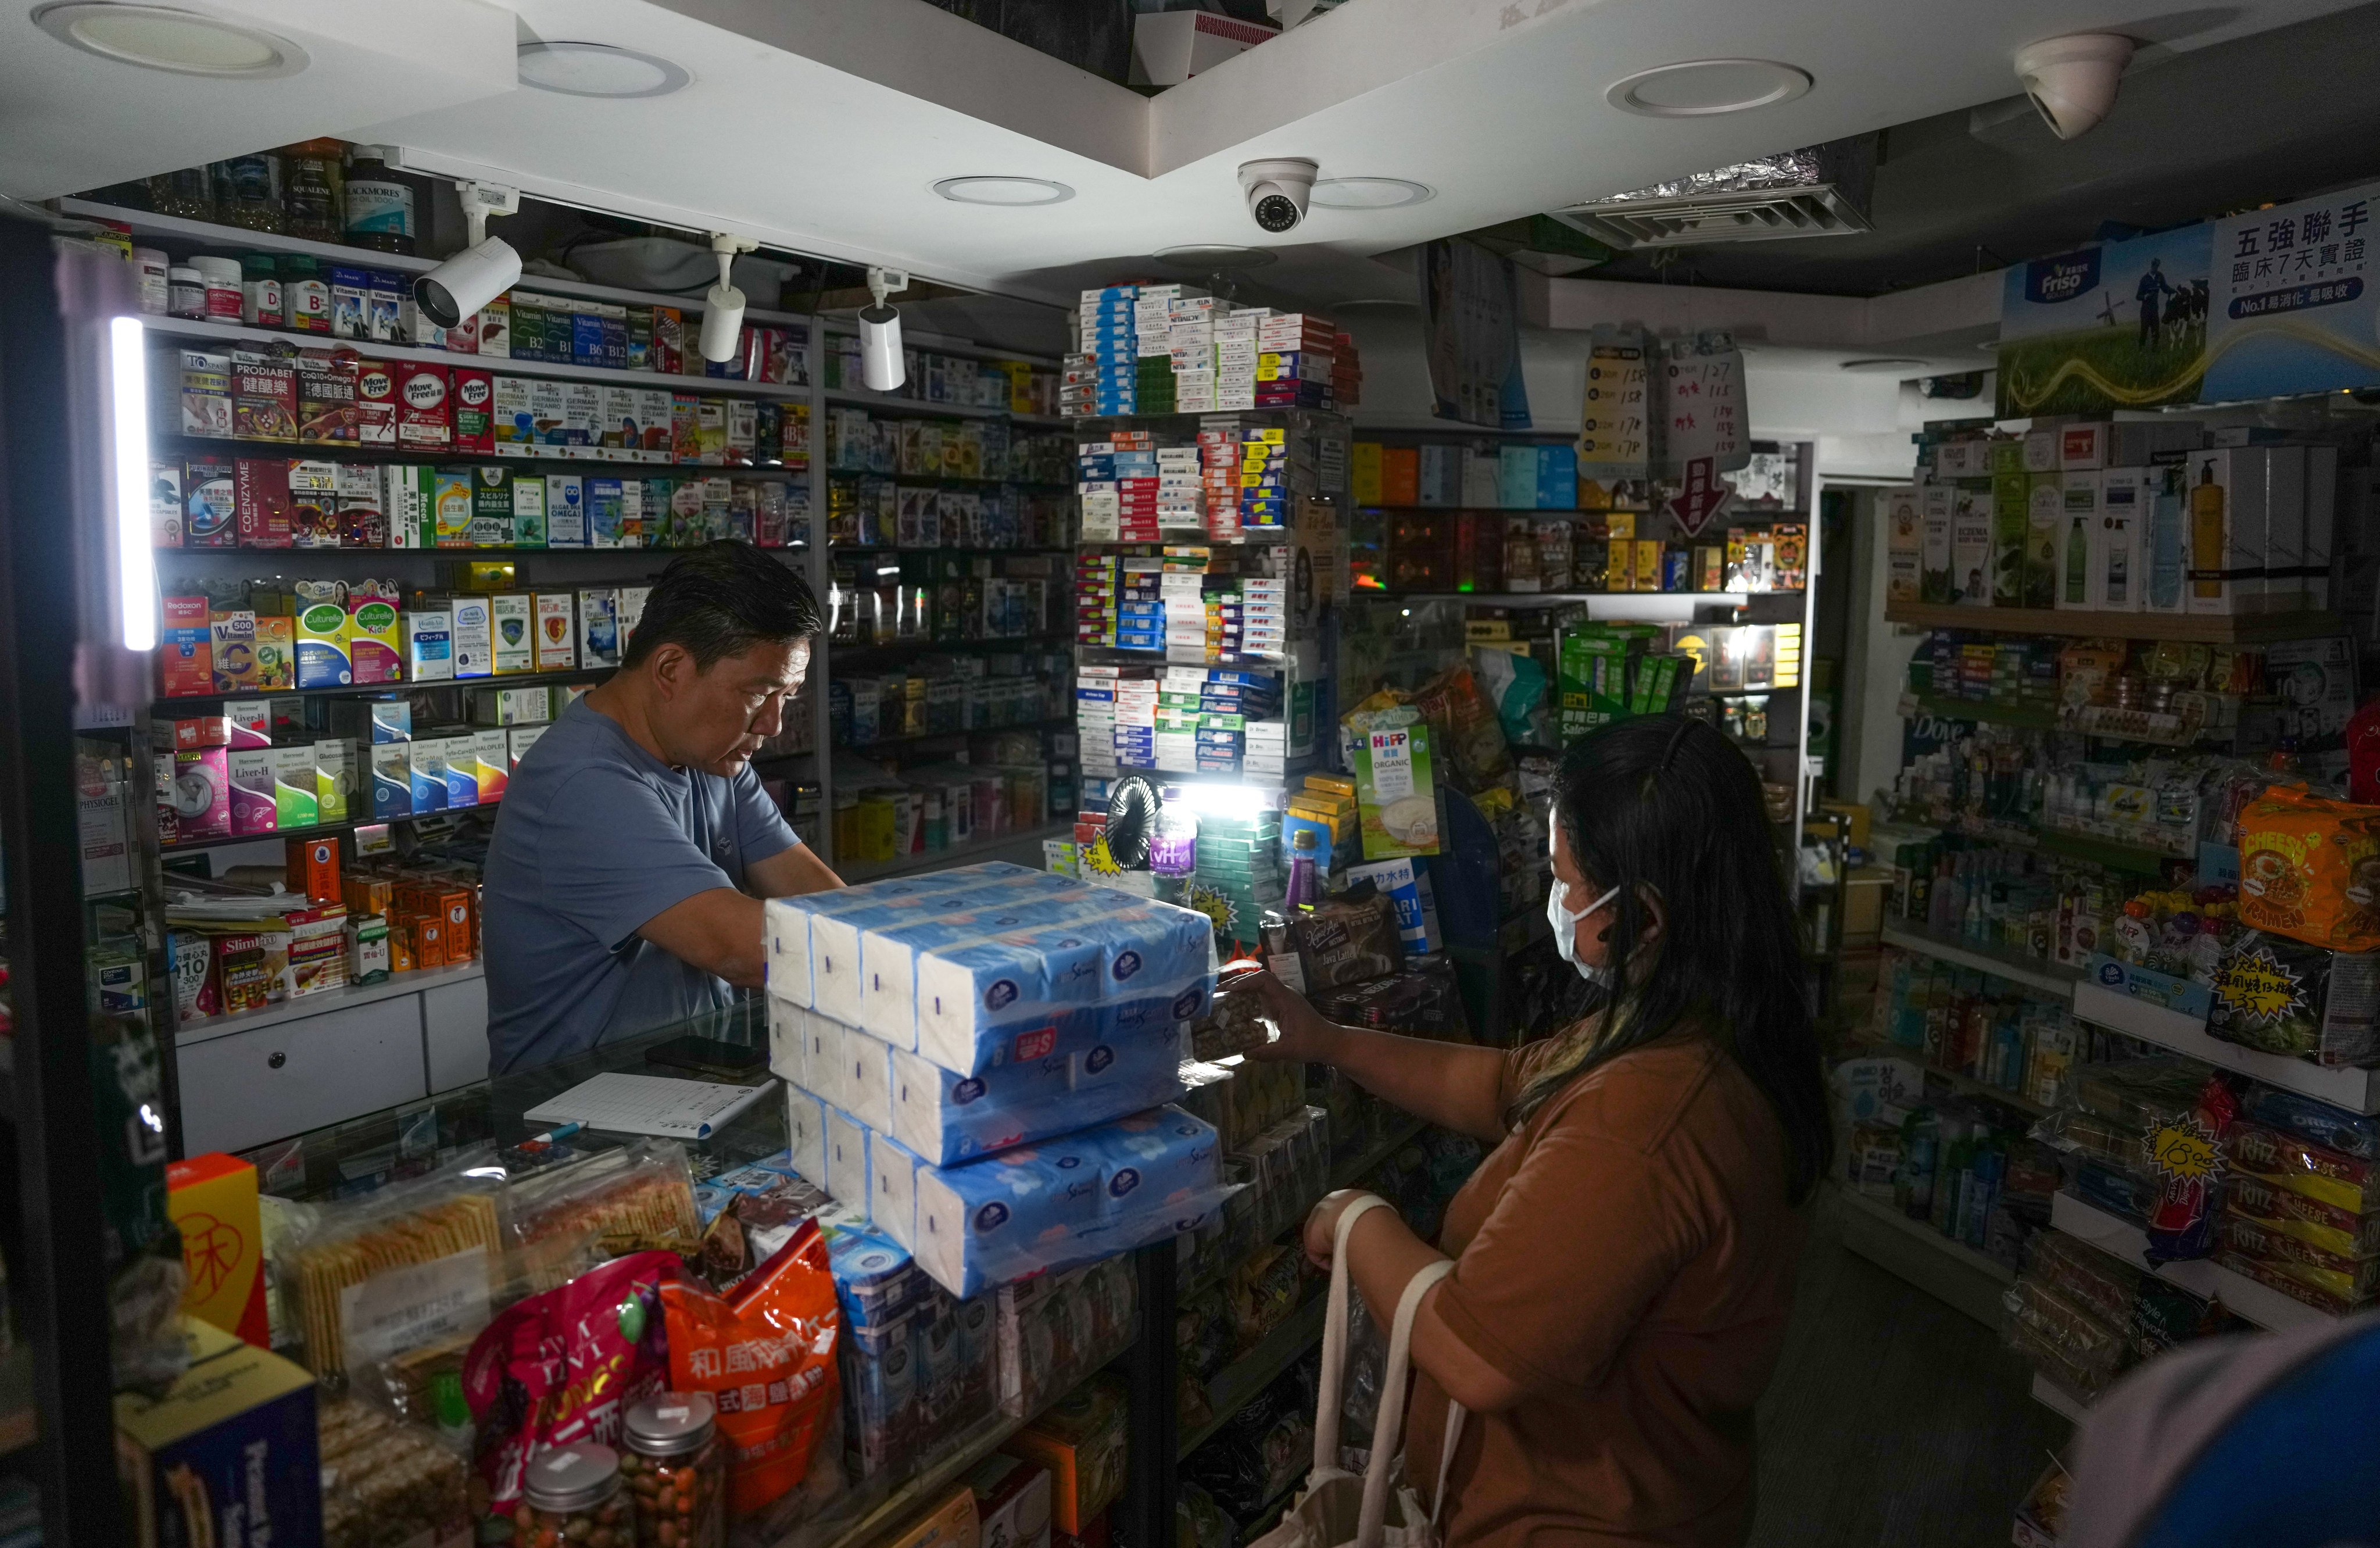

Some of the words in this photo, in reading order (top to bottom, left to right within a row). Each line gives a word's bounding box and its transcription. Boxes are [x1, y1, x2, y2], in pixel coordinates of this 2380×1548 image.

[292, 185, 331, 196] SQUALENE
[347, 185, 400, 199] LACKMORES
[2234, 200, 2369, 258] 五強聯手
[2232, 237, 2366, 284] 臨床7天實證
[2041, 273, 2082, 295] Friso
[335, 287, 357, 296] Vitamin
[357, 289, 367, 298] B2
[374, 291, 395, 301] Vitamin
[2309, 283, 2349, 303] 易吸收
[515, 308, 542, 321] Vitamin
[545, 313, 571, 326] Vitamin
[1171, 314, 1199, 323] ACTIVELIN
[576, 316, 600, 328] Vitamin
[602, 320, 625, 331] Vitamin
[529, 337, 543, 349] B2
[559, 341, 571, 353] B1
[589, 343, 602, 356] B6
[608, 345, 626, 357] B12
[237, 364, 294, 380] PRODIABET
[301, 371, 352, 384] CoQ10+Omega
[362, 376, 389, 387] Move
[367, 384, 389, 395] Free
[407, 383, 433, 394] Move
[463, 383, 486, 393] Move
[411, 391, 430, 401] Free
[468, 390, 486, 399] Free
[496, 392, 528, 401] GERMANY
[532, 396, 563, 404] GERMANY
[496, 399, 527, 407] PROSTRO
[239, 461, 252, 534] COENZYME
[420, 492, 430, 523] Mecol
[551, 510, 581, 518] OMEGA3
[167, 602, 202, 610] Redoxon
[305, 614, 342, 624] Culturelle
[358, 612, 392, 622] Culturelle
[234, 621, 252, 630] 500
[367, 624, 386, 634] Kids
[214, 625, 255, 640] Vitamin
[234, 714, 264, 723] Liver-H
[1913, 717, 1965, 744] Dove
[475, 743, 505, 752] HALOPLEX
[1372, 734, 1407, 749] HiPP
[1373, 759, 1410, 770] ORGANIC
[235, 767, 269, 779] Liver-H
[80, 797, 120, 810] PHYSIOGEL
[2244, 831, 2307, 867] CHEESY
[2244, 901, 2306, 931] RAMEN
[224, 934, 276, 953] SlimPro
[1328, 934, 1347, 947] INSTANT
[1322, 953, 1336, 966] Java
[183, 974, 199, 985] 300
[2292, 1114, 2338, 1136] OREO
[2237, 1136, 2277, 1167] RITZ
[2238, 1181, 2273, 1211] RITZ
[2232, 1222, 2267, 1251] RITZ
